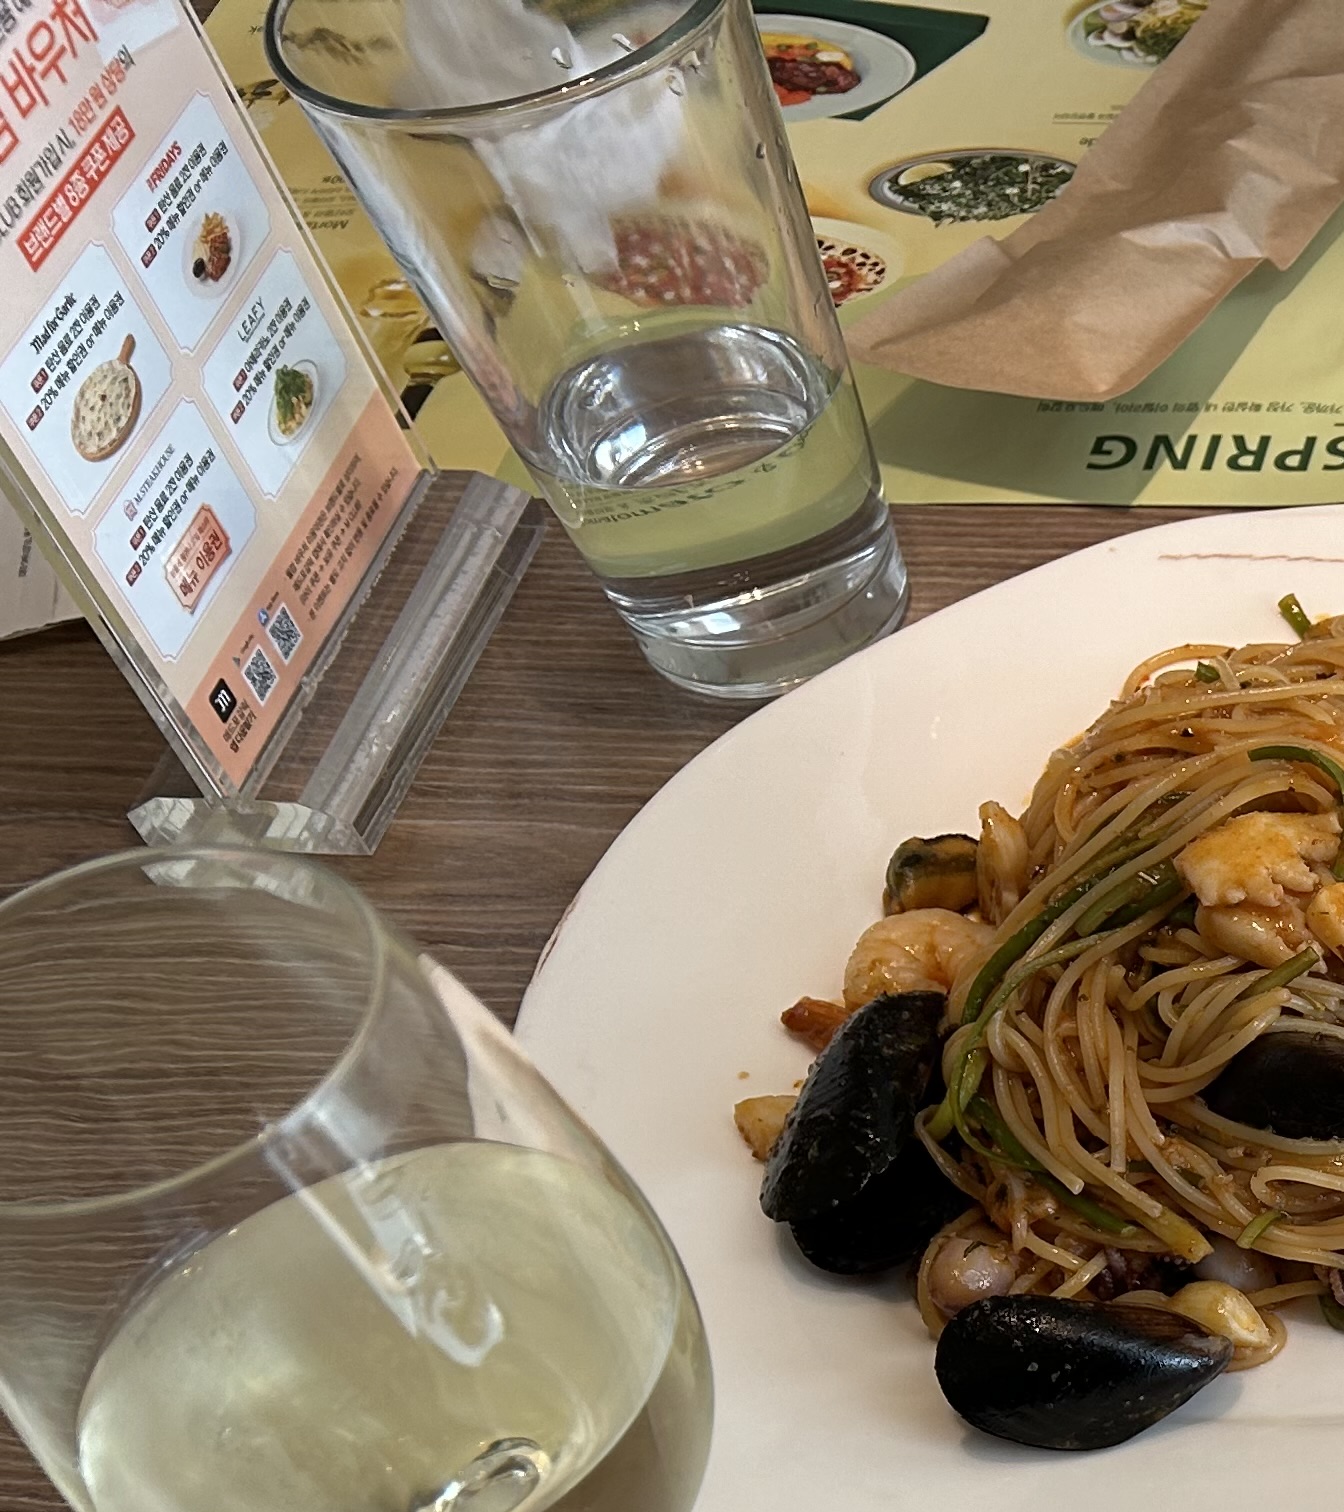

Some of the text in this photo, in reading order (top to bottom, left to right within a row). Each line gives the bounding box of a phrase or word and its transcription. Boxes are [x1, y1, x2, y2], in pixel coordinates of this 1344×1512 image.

[1, 0, 98, 119] 바우처
[20, 113, 130, 264] 브랜드별 8종 쿠폰 제공
[234, 295, 268, 342] LEAFY
